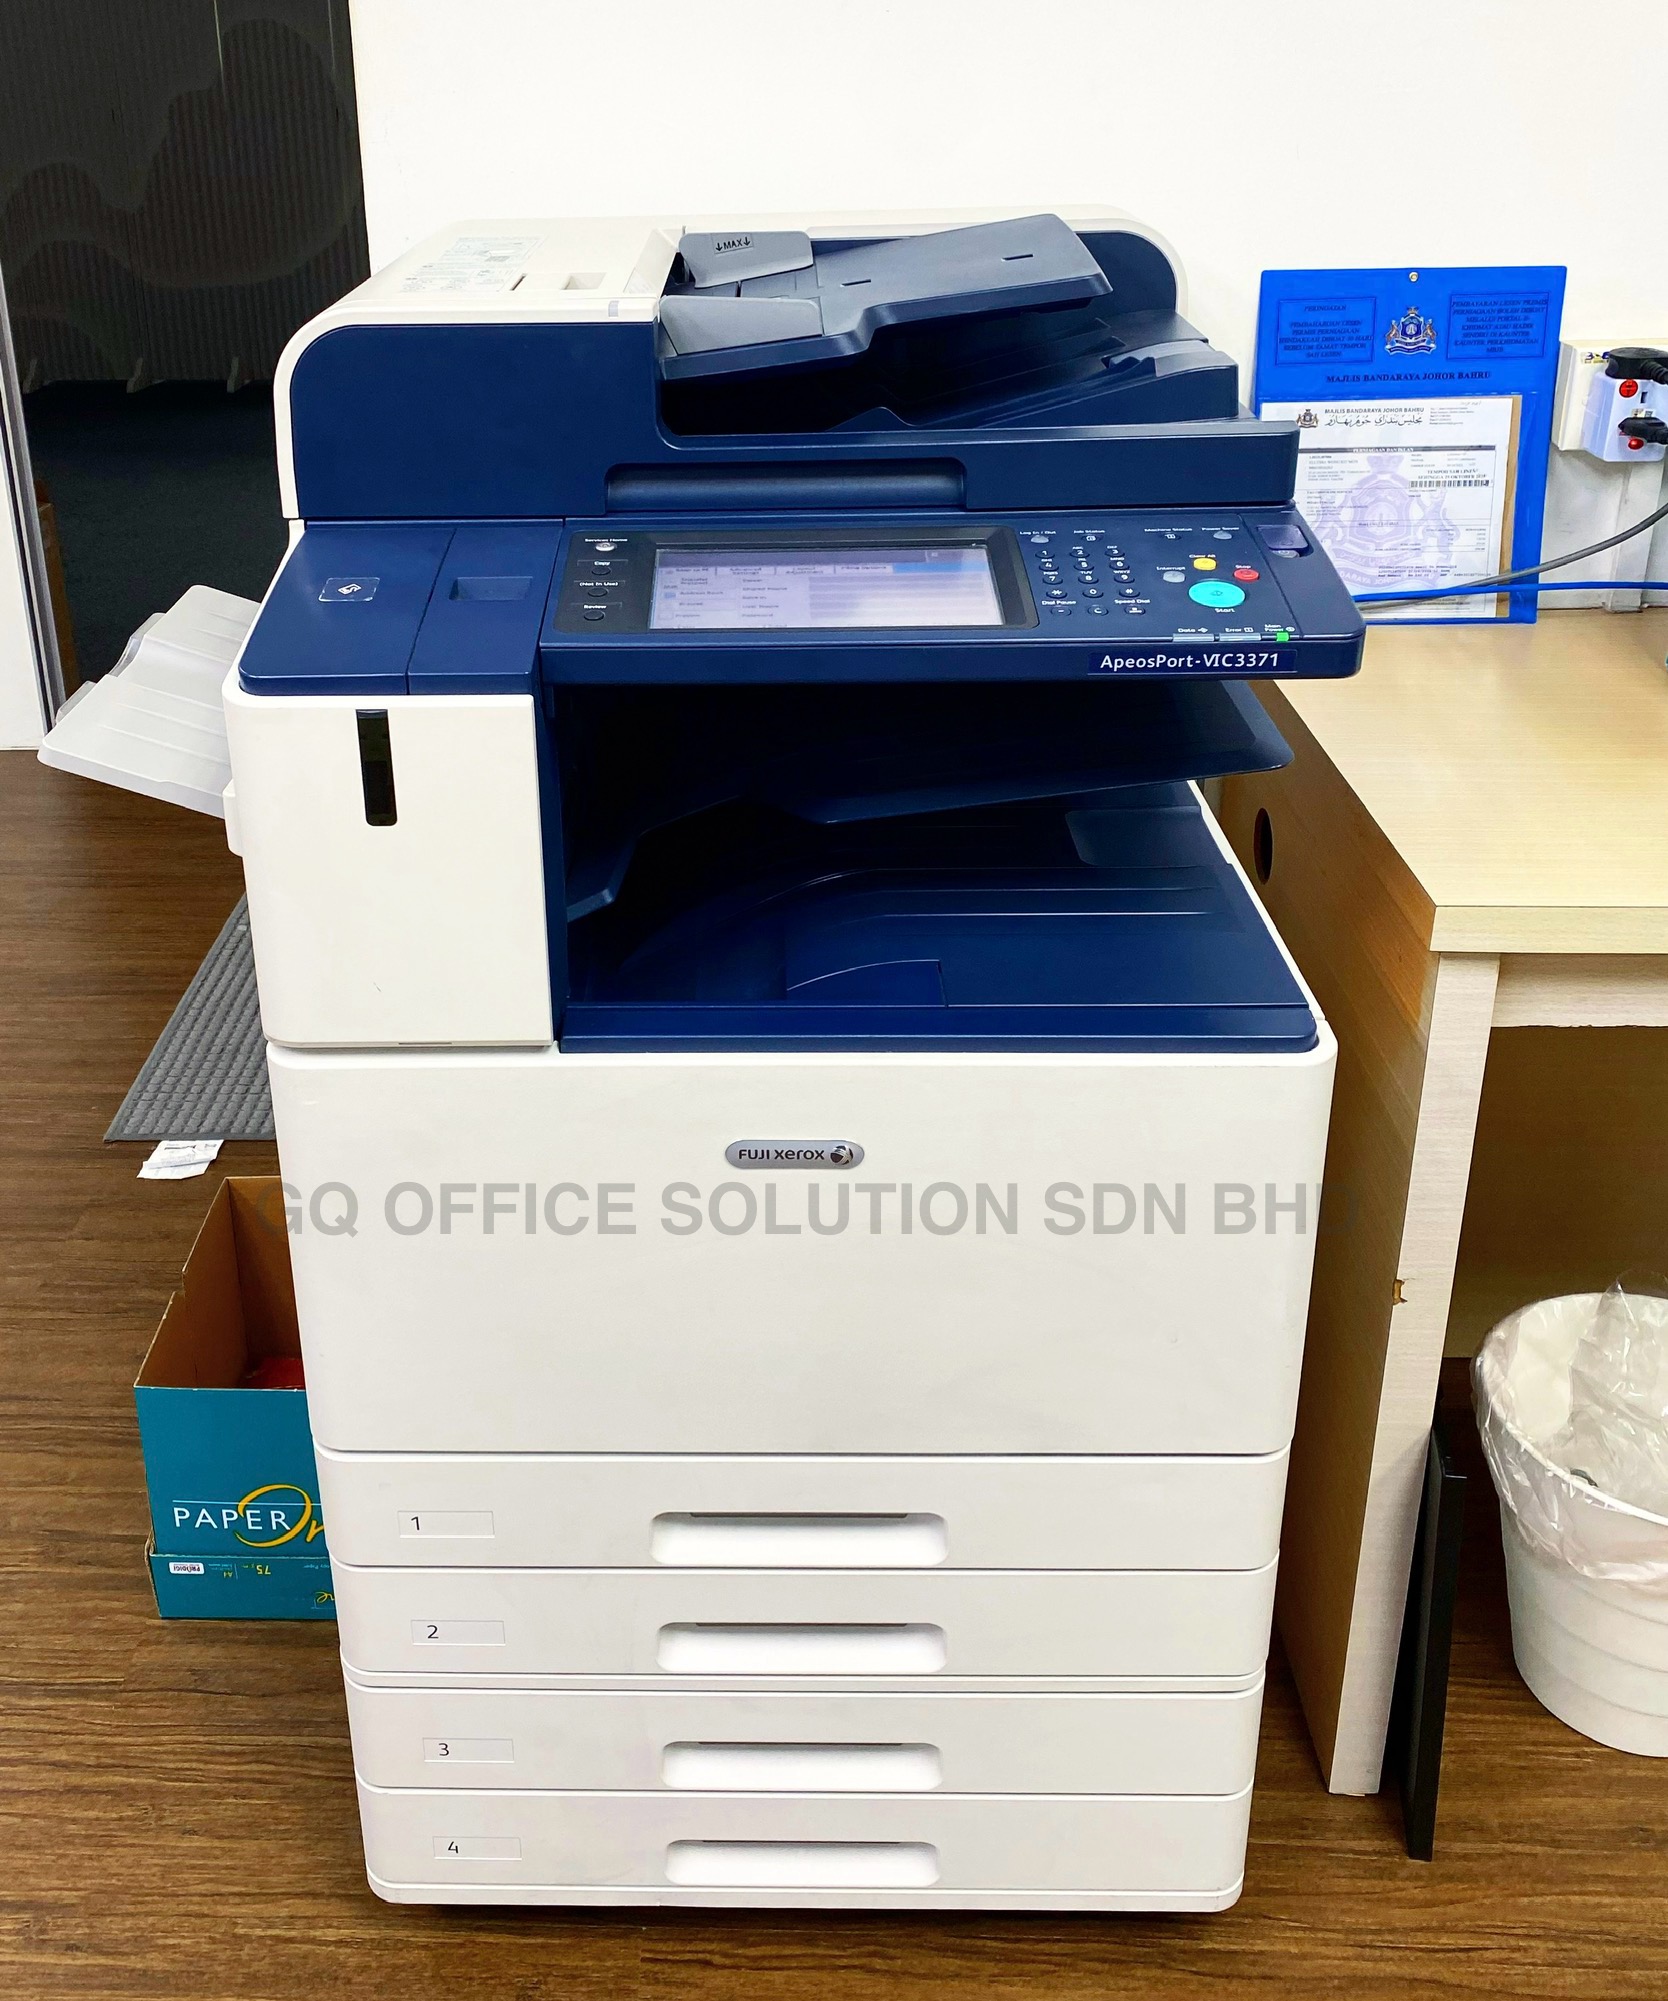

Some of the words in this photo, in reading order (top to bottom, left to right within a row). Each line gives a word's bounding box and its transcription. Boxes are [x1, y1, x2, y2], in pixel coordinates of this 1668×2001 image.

[723, 238, 743, 250] MAX
[1326, 375, 1361, 383] MAJLIS
[1363, 374, 1421, 382] BANDARAYA
[1422, 372, 1455, 380] JOHOR
[1457, 371, 1492, 379] BAHRU
[738, 1149, 770, 1160] FUJI
[774, 1149, 825, 1160] xerox
[172, 1506, 292, 1531] PAPER
[410, 1515, 421, 1532] 1
[256, 1564, 272, 1575] 75
[426, 1624, 439, 1639] 2
[438, 1743, 450, 1757] 3
[447, 1841, 459, 1854] 4
